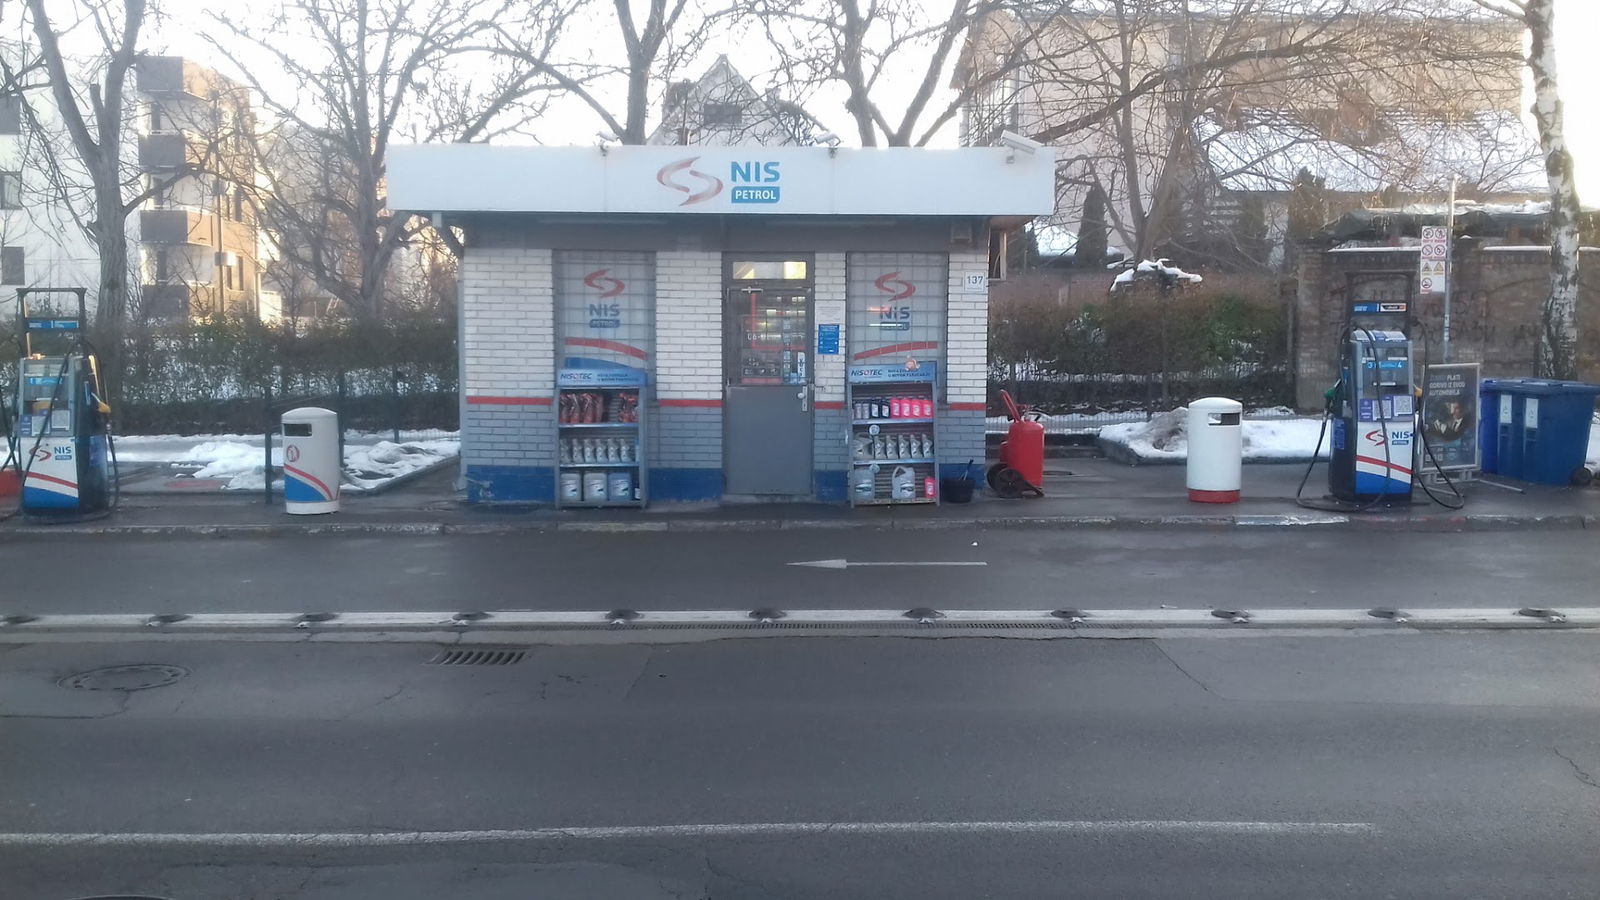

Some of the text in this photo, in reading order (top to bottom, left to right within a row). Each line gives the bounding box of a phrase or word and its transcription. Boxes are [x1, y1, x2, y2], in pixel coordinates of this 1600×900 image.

[731, 161, 780, 183] NIS
[735, 189, 777, 200] PETROL
[967, 275, 983, 284] 137
[589, 304, 620, 316] NIS
[880, 306, 910, 319] NIS
[1391, 431, 1410, 439] NIS
[54, 446, 72, 454] NIS
